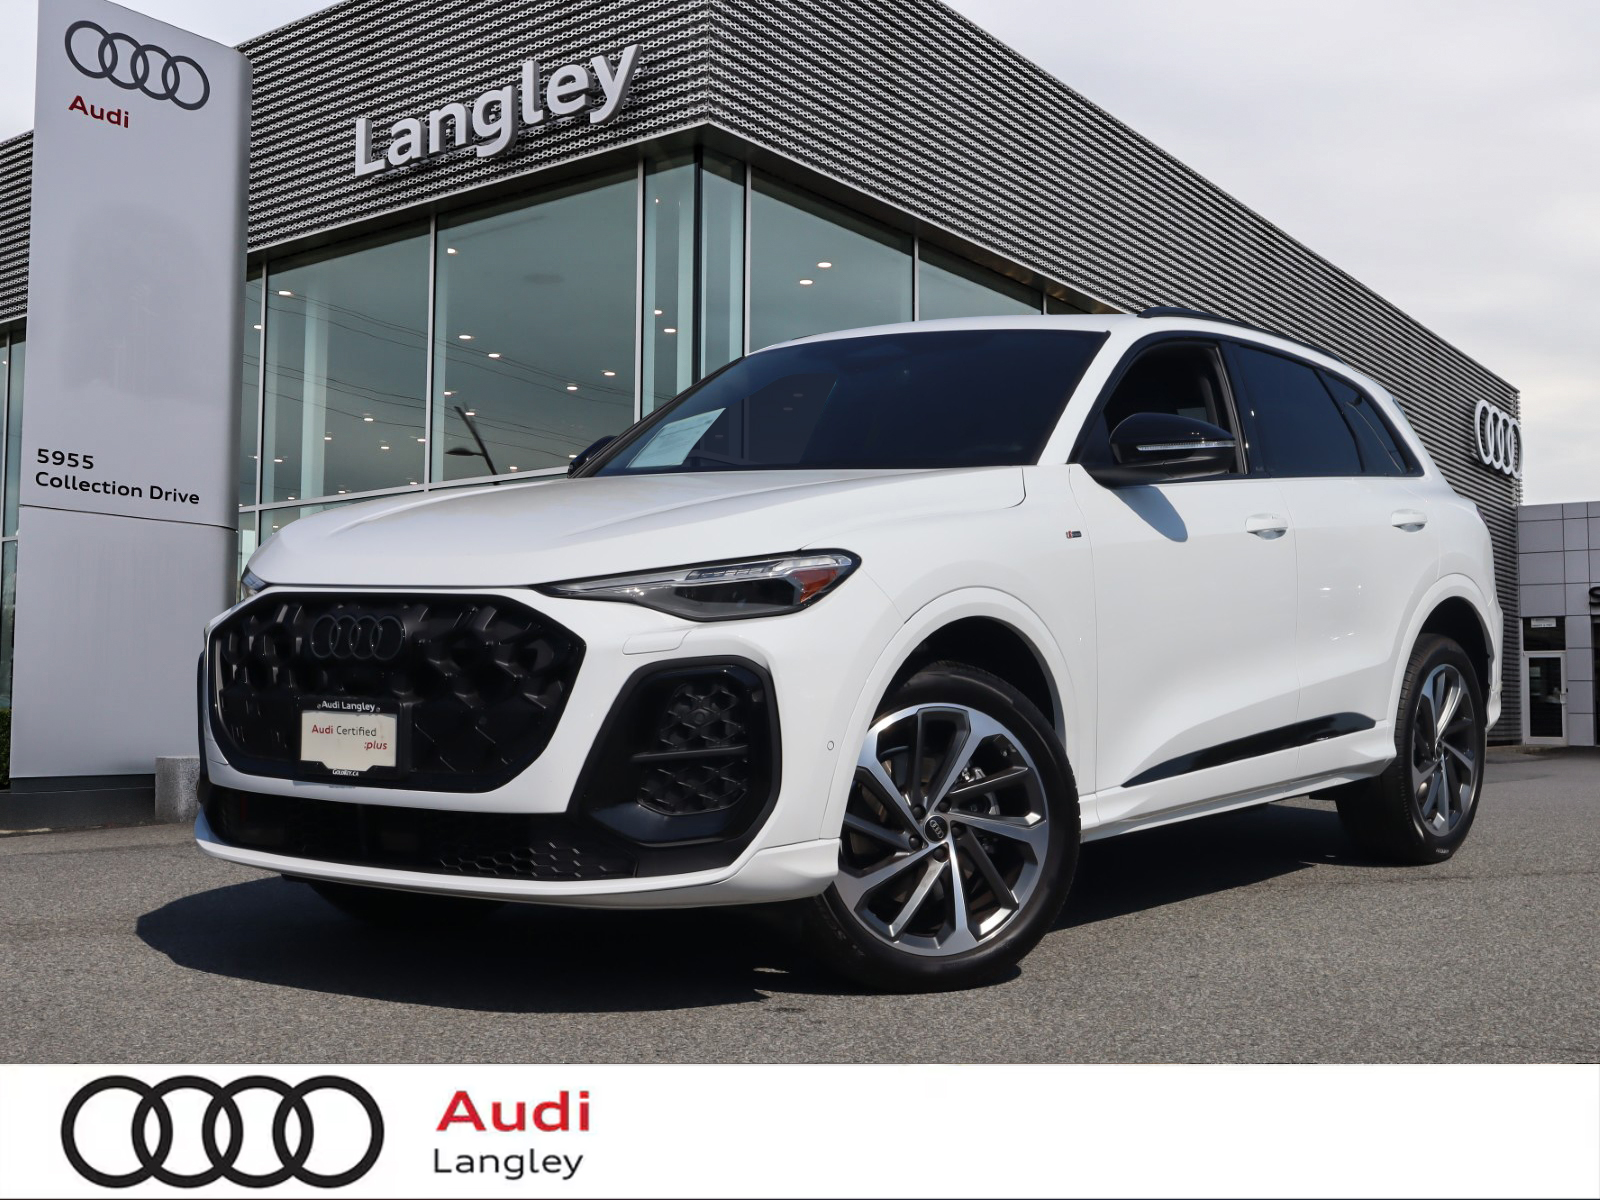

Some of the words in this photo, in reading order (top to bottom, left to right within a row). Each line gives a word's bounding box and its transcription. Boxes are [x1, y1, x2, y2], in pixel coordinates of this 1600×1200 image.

[68, 95, 129, 129] Audi
[354, 43, 643, 178] Langley
[36, 448, 94, 470] 5955
[35, 471, 143, 498] Collection
[149, 485, 200, 505] Drive
[321, 700, 340, 709] Audi
[341, 701, 376, 712] Langley
[311, 724, 334, 735] Audi
[336, 725, 377, 737] Certified
